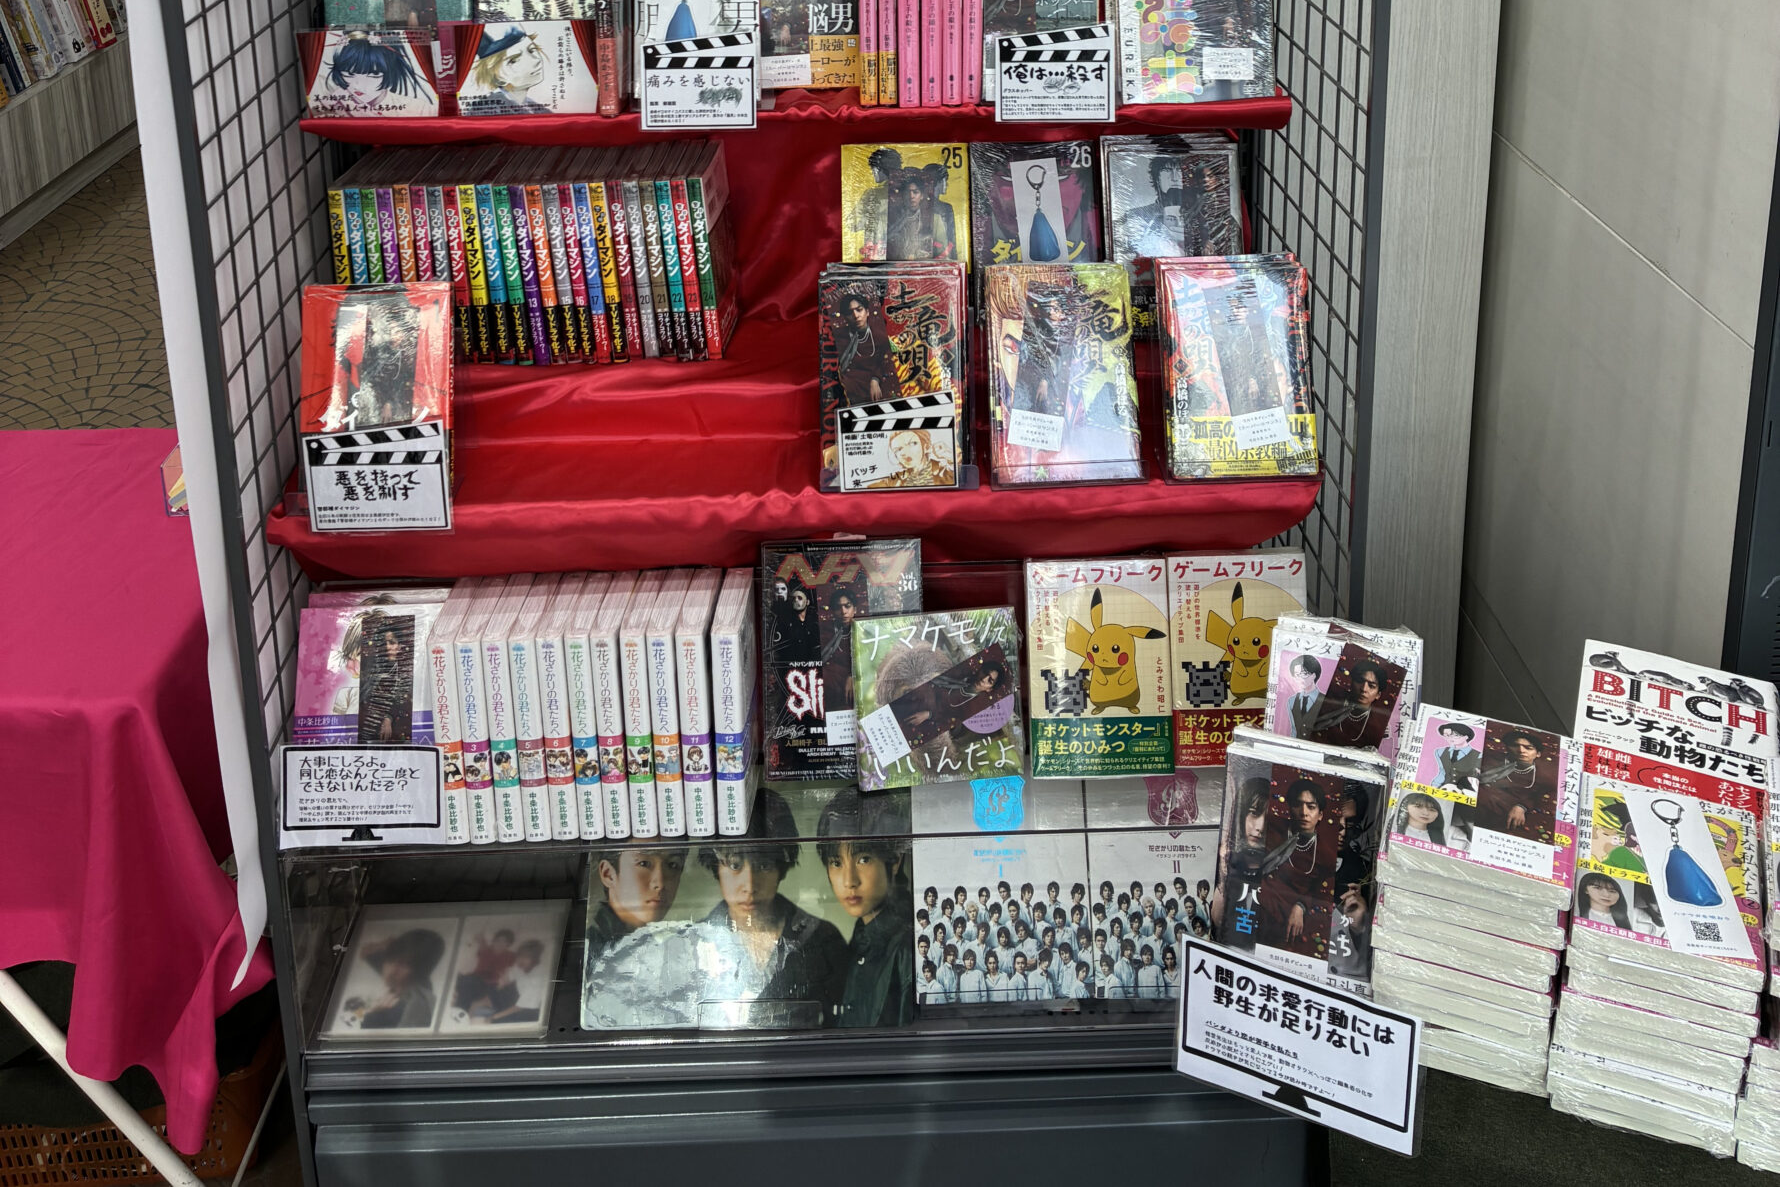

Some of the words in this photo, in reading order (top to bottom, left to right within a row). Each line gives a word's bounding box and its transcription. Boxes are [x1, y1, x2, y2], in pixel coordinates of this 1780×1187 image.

[808, 2, 854, 34] 脳男
[646, 74, 751, 89] 痛みを感じない
[1122, 26, 1135, 101] EUREKA
[941, 147, 963, 169] 25
[1070, 145, 1092, 169] 26
[886, 281, 957, 384] 土竜の唄
[334, 470, 421, 486] 悪を持って
[343, 482, 416, 501] 悪を制す
[1174, 559, 1304, 580] ゲームフリーク
[1177, 585, 1185, 643] クリエイティブ集団
[861, 616, 1008, 661] ナマケモノで
[432, 654, 452, 741] 花ざかりの君たちへ
[460, 654, 479, 740] 花ざかりの君たちへ
[487, 653, 507, 738] 花ざかりの君たちへ
[512, 652, 532, 737] 花ざかりの君たちへ
[541, 651, 560, 735] 花ざかりの君たちへ
[569, 650, 588, 735] 花ざかりの君たちへ
[595, 648, 615, 734] 花ざかりの君たちへ
[1156, 657, 1165, 713] とみさわ昭仁
[1592, 669, 1769, 736] BITCH
[1038, 722, 1161, 739] 『ポケットモンスター』
[1586, 705, 1696, 745] ビッチな
[1587, 698, 1625, 711] Evolution
[1642, 709, 1655, 718] the
[1658, 714, 1689, 726] Female
[1690, 722, 1717, 733] Animal
[1651, 708, 1675, 718] Guide
[299, 756, 387, 769] 大事にしろよ。
[1037, 740, 1126, 756] 誕生のひみつ
[1639, 734, 1766, 784] 動物たち
[299, 768, 421, 781] 同じ恋なんて二度と
[300, 780, 408, 793] できないんだぞ?
[1402, 780, 1478, 807] 連続ドラマ化
[1559, 739, 1583, 824] 苦手な私たち
[1579, 807, 1592, 851] 瀬那和章
[1739, 810, 1758, 895] 苦手な私たち
[1237, 884, 1262, 905] パ
[1235, 907, 1256, 935] 苦
[1193, 958, 1396, 1045] 人間の求愛行動には
[1213, 986, 1370, 1057] 野生が足りない
[1205, 1020, 1300, 1060] パンダより恋が苦手な私たち
